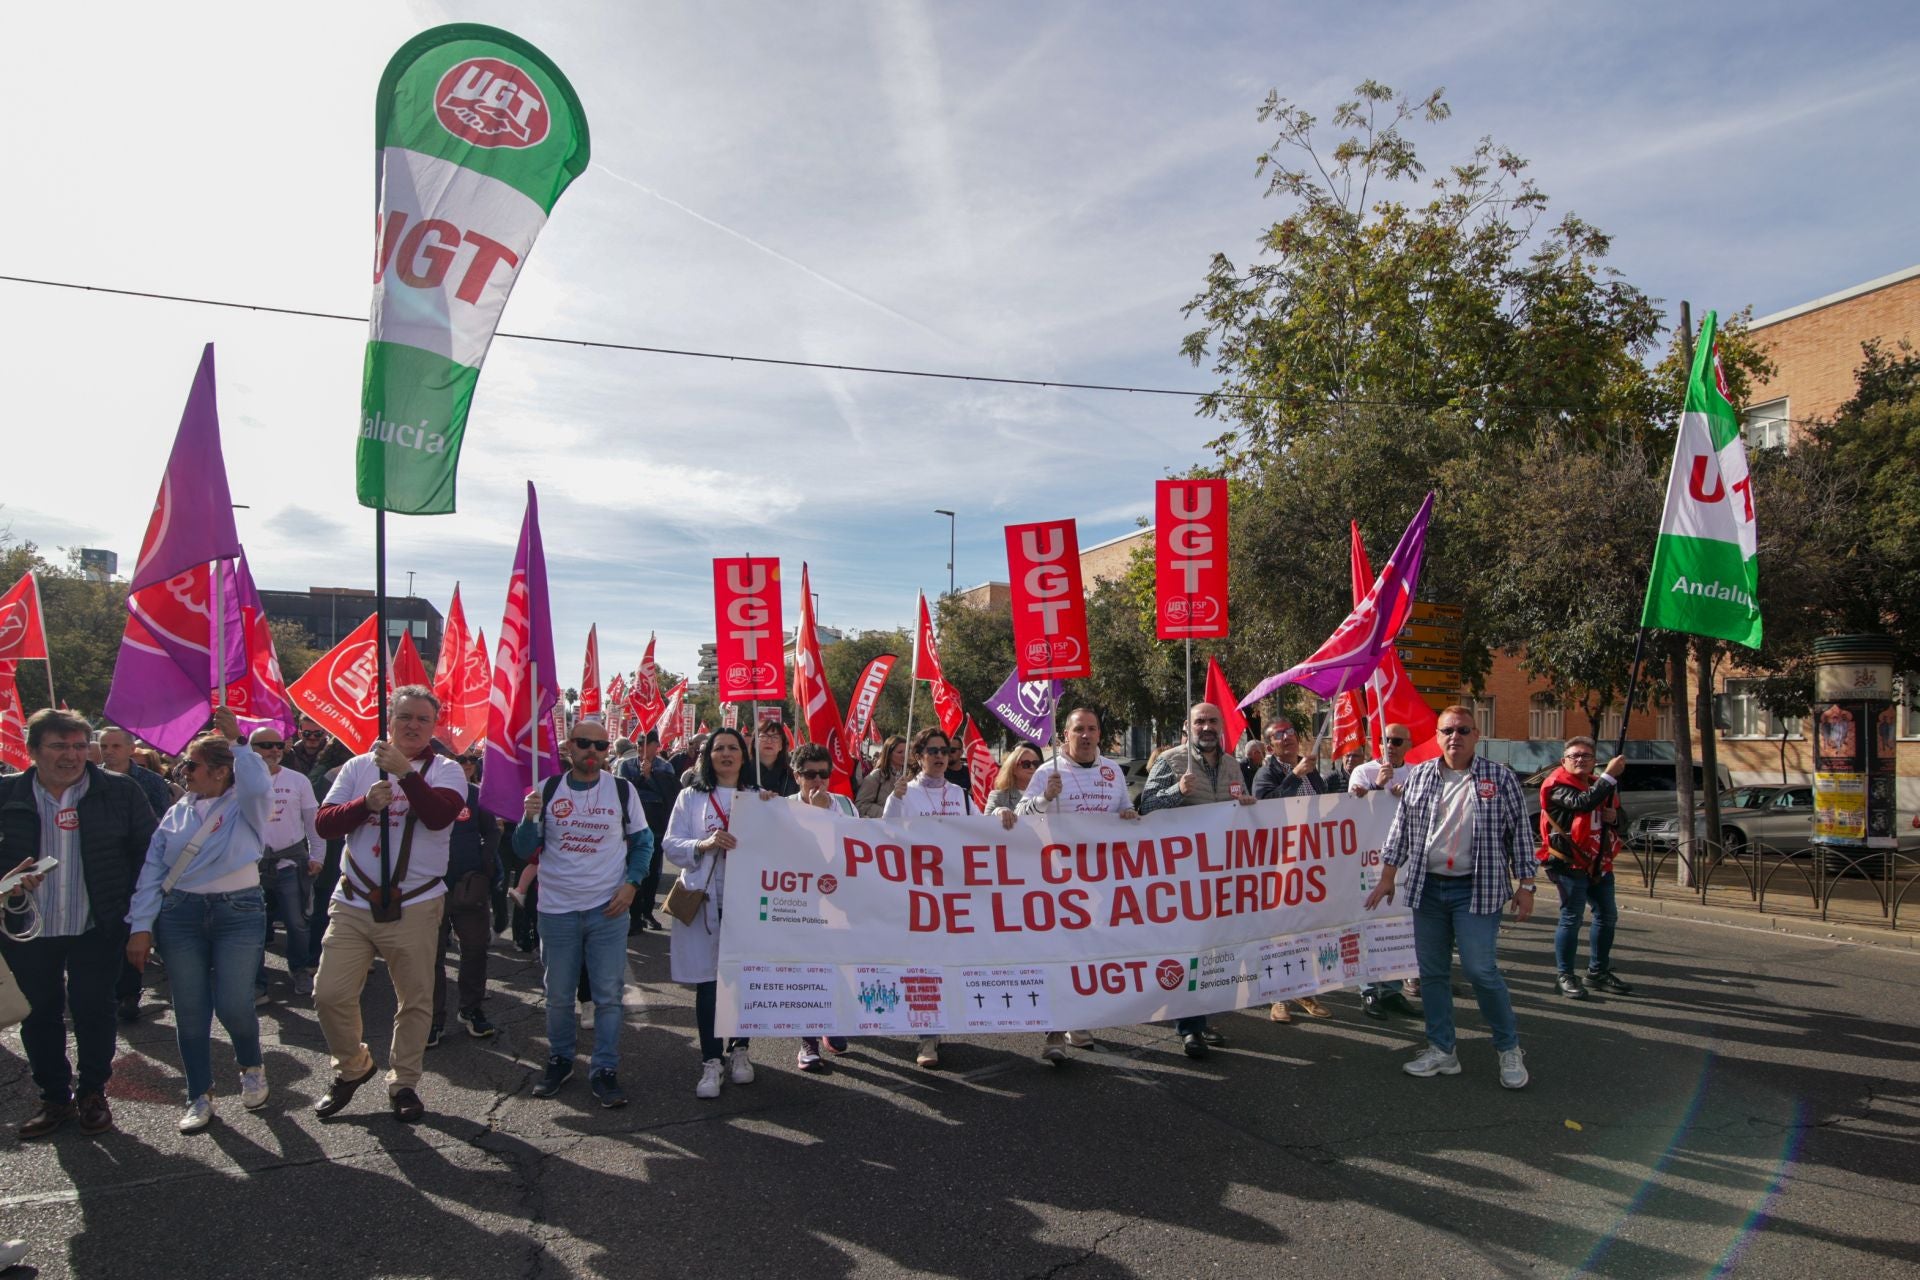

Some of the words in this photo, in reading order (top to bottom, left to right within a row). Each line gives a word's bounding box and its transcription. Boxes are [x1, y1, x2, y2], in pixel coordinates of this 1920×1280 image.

[455, 65, 541, 128] UGT
[1168, 486, 1214, 594] UGT
[1021, 527, 1071, 636] UGT
[726, 564, 770, 661] UGT
[1075, 803, 1109, 812] Sanidad
[571, 820, 610, 830] Primero
[560, 832, 605, 843] Sanidad
[560, 843, 597, 853] Pública
[843, 837, 944, 887] POR
[962, 845, 1025, 886] EL
[1040, 819, 1358, 885] CUMPLIMIENTO
[761, 870, 813, 893] UGT
[772, 897, 807, 907] Córdoba
[908, 889, 975, 933] DE
[991, 888, 1092, 932] LOS
[1109, 865, 1327, 927] ACUERDOS
[772, 915, 801, 923] Servicios
[802, 916, 828, 924] Públicos
[1202, 952, 1235, 967] Córdoba
[1070, 961, 1148, 995] UGT
[1200, 978, 1230, 990] Servicios
[1231, 973, 1258, 984] Públicos
[786, 983, 828, 992] HOSPITAL,
